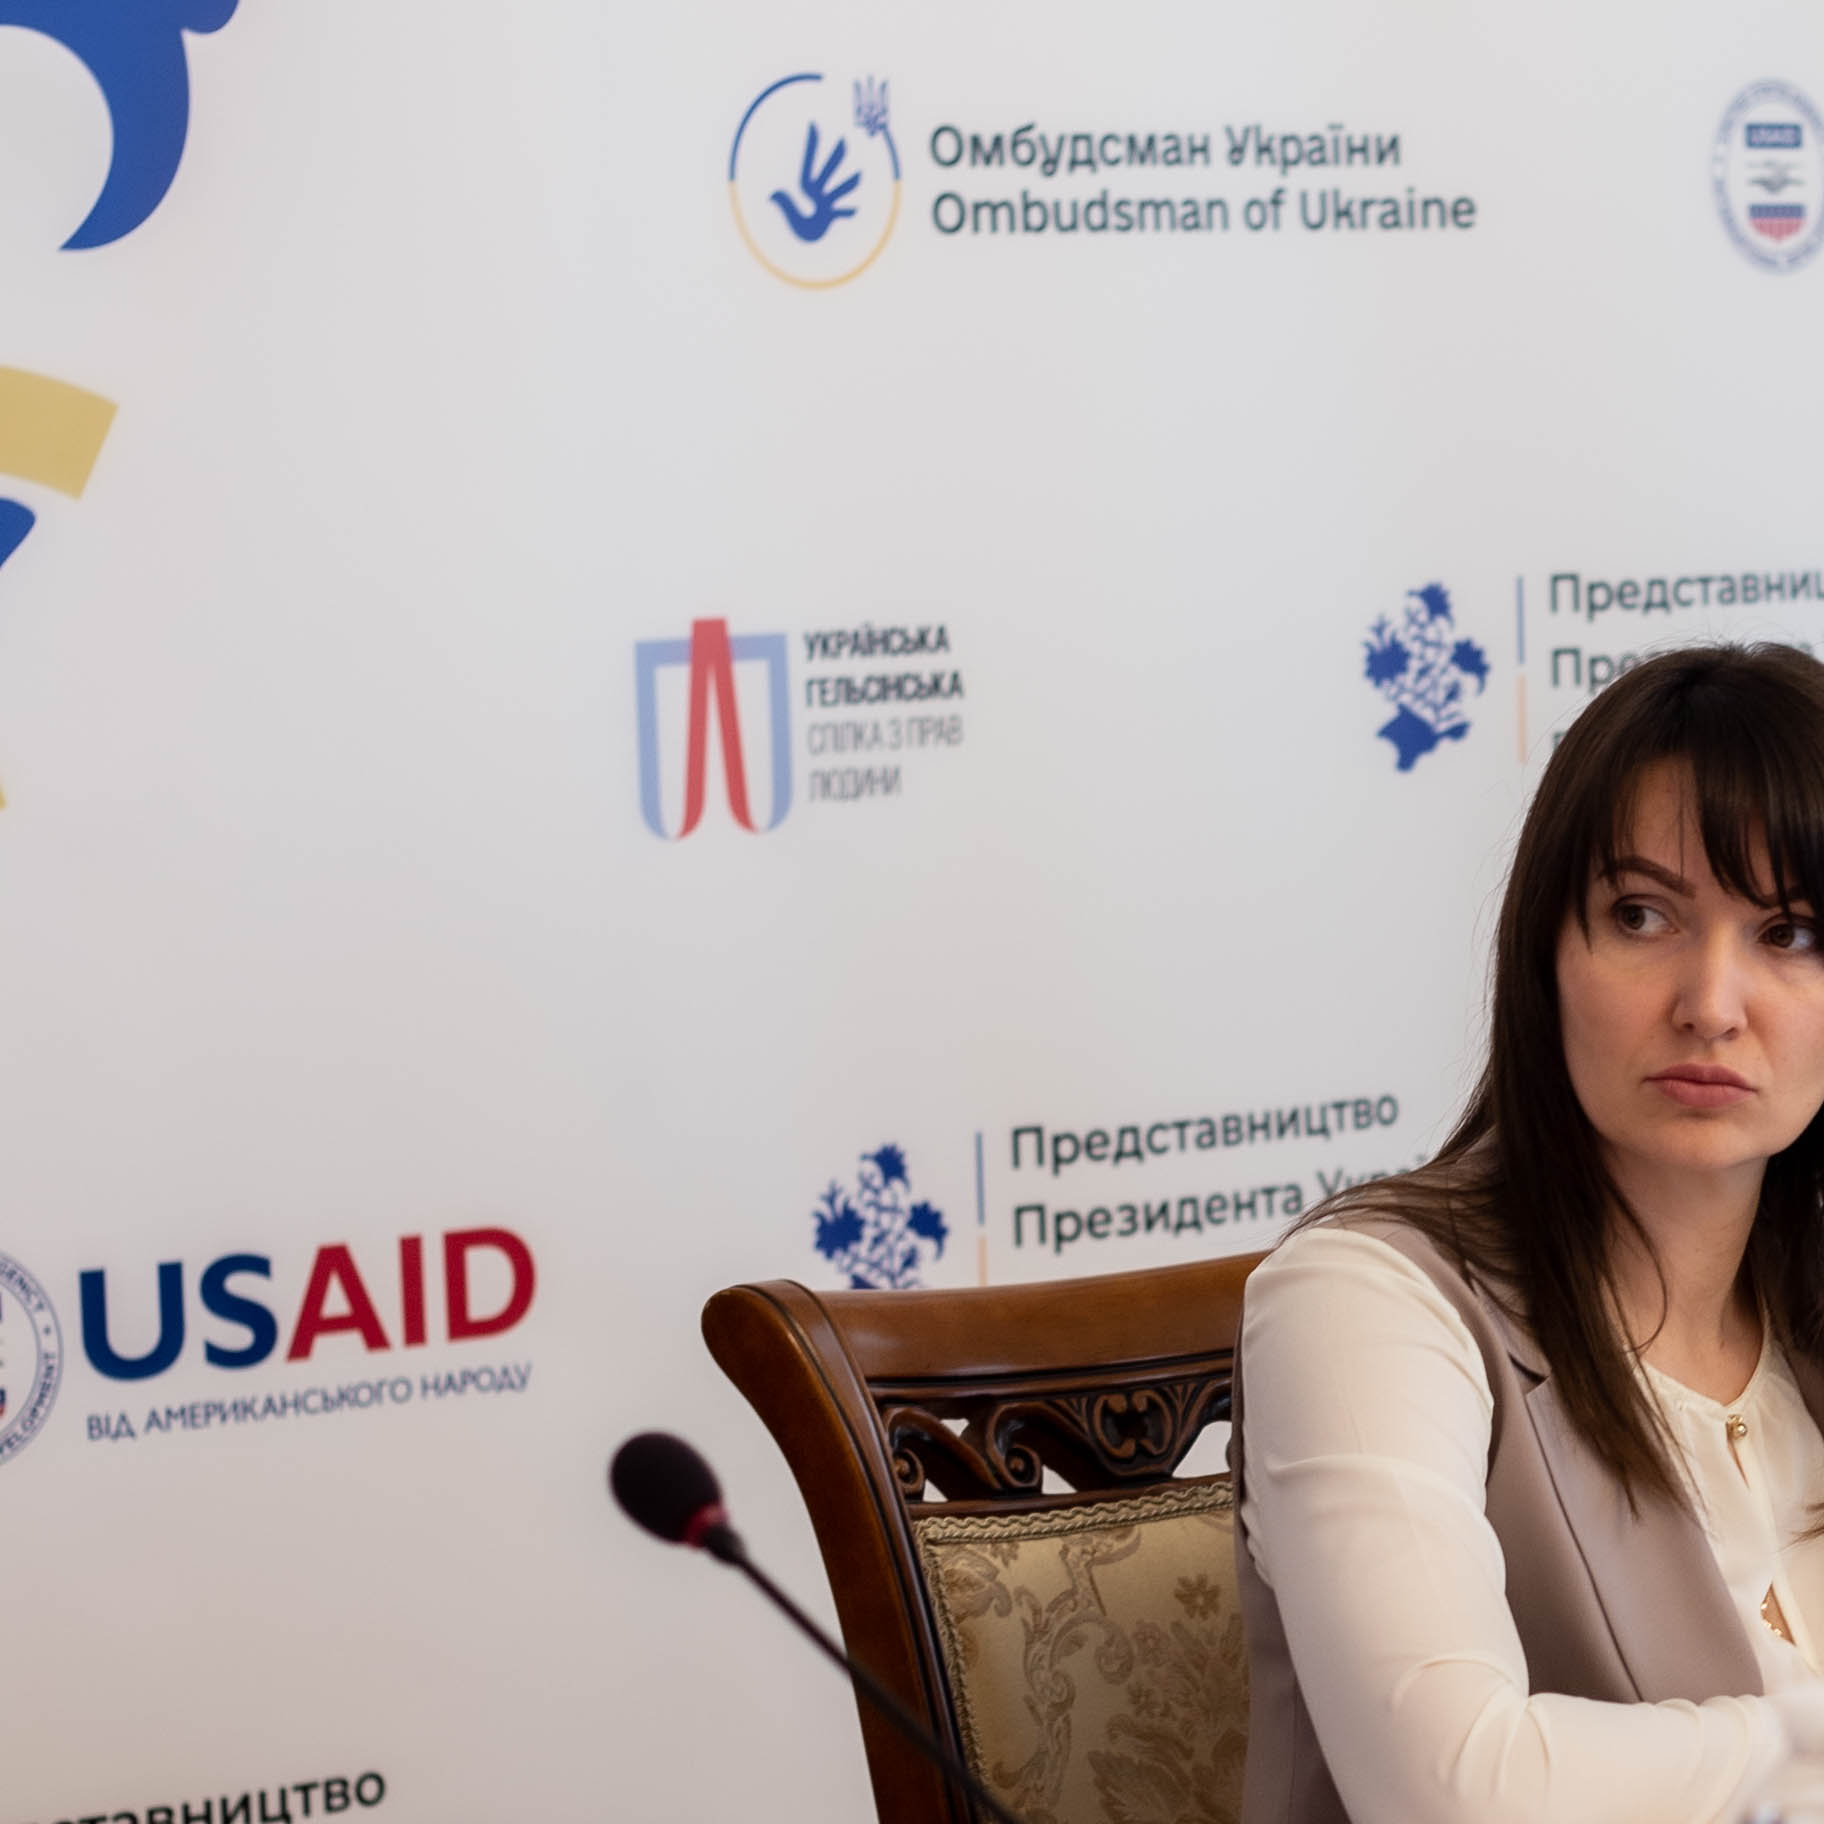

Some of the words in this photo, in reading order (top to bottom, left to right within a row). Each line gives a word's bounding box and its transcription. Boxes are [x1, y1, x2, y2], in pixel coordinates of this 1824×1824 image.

[929, 123, 1211, 178] Омбудсман
[1225, 123, 1402, 175] України
[931, 189, 1229, 234] Ombudsman
[1242, 187, 1288, 232] of
[1300, 187, 1477, 231] Ukraine
[803, 622, 950, 661] УКРАЇНСЬКА
[805, 670, 965, 708] ГЕЛЬСІНСЬКА
[1010, 1090, 1399, 1178] Представництво
[1012, 1180, 1304, 1254] Президента
[79, 1226, 536, 1383] USAID
[87, 1412, 138, 1442] ВІД
[144, 1376, 413, 1436] АМЕРИКАНСЬКОГО
[421, 1362, 534, 1401] НАРОДУ
